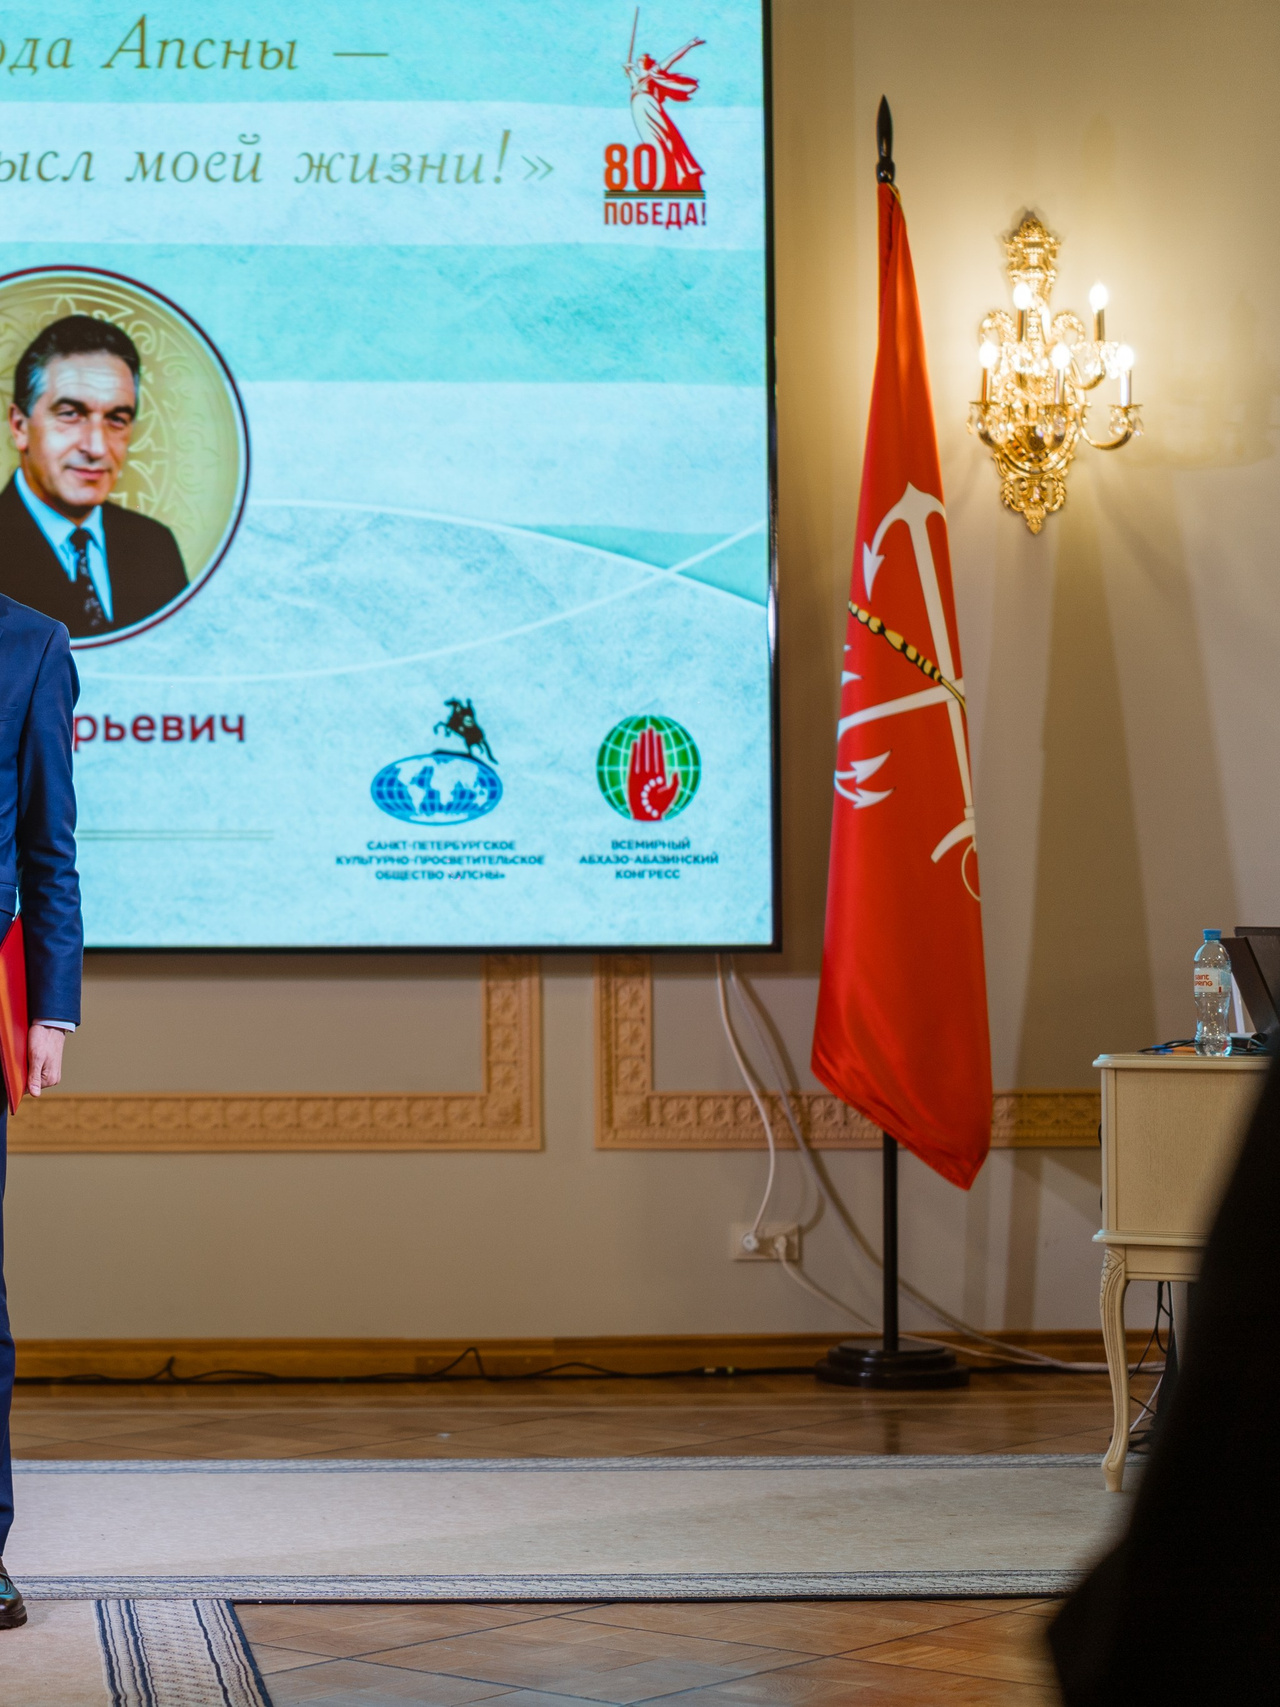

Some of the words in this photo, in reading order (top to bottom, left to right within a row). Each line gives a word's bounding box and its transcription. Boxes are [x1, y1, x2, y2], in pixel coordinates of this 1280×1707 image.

[100, 13, 299, 72] Апсны
[125, 133, 264, 184] моей
[294, 129, 555, 185] жизни!»
[604, 143, 657, 191] 80
[603, 202, 706, 230] ПОБЕДА!
[73, 714, 246, 753] рьевич
[366, 840, 516, 851] САНКТ-ПЕТЕРБУРГСКОЕ
[610, 837, 691, 850] ВСЕМИРНЫЙ
[335, 855, 545, 866] КУЛЬТУРНО-ПРОСВЕТИТЕЛЬСКОЕ
[579, 851, 719, 864] АБХАЗО-АБАЗИНСКИЙ
[375, 870, 445, 881] ОБЩЕСТВО
[615, 869, 681, 880] КОНГРЕСС
